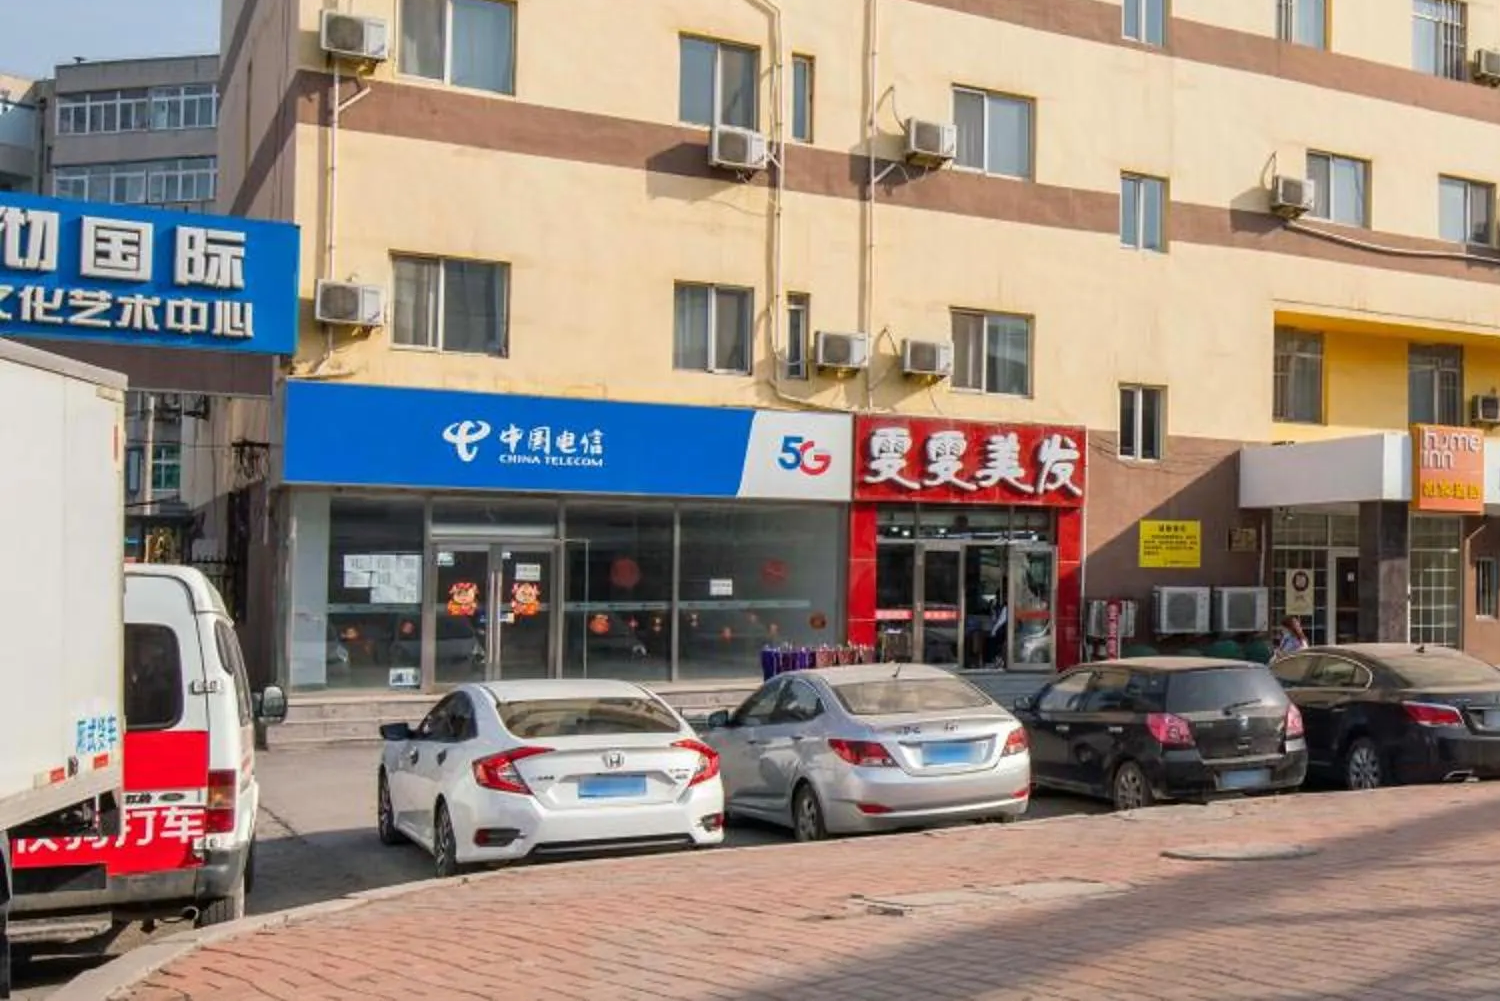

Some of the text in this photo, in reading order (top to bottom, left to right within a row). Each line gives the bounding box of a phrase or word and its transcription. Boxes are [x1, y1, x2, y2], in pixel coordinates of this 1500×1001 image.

[499, 423, 604, 455] 中国电信
[499, 454, 604, 467] CHINA TELECOM
[778, 435, 832, 476] 5G
[864, 427, 1083, 497] 雯雯美发
[1422, 449, 1454, 470] inn
